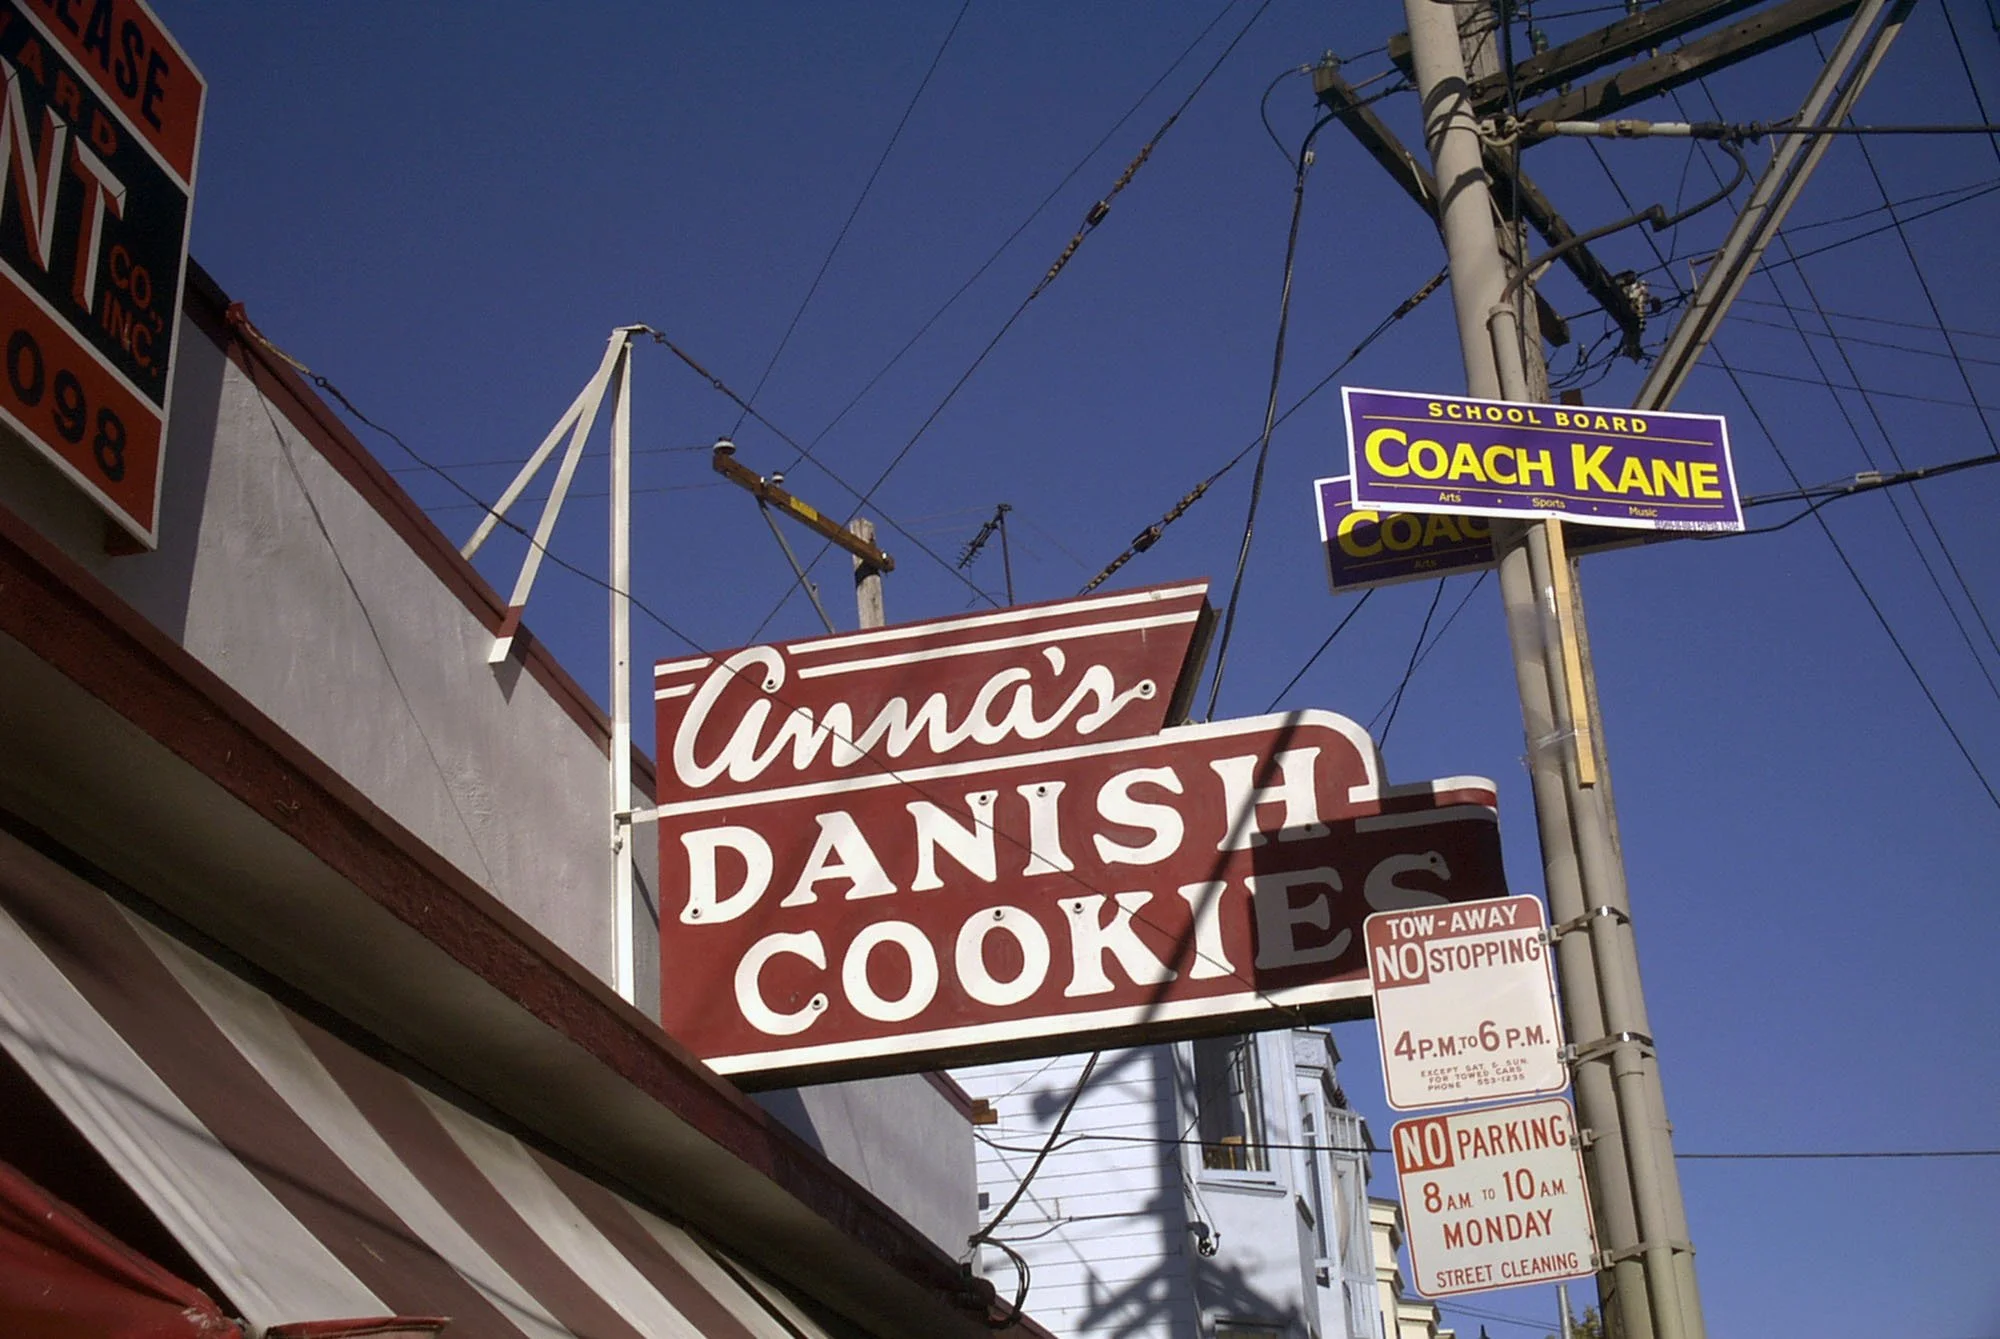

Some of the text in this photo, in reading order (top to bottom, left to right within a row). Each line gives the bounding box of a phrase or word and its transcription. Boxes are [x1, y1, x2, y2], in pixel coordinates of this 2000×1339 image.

[44, 0, 169, 132] EASE
[102, 289, 159, 378] INC.
[7, 329, 126, 482] 098
[1428, 402, 1648, 433] SCHOOL BOARD
[1364, 427, 1723, 499] COACH KANE
[1438, 491, 1658, 518] Arts Sports Music
[672, 645, 1157, 789] Anna's
[680, 743, 1326, 925] DANISH
[733, 850, 1453, 1036] COOKIES
[1386, 904, 1518, 941] TOW-AWAY
[1375, 936, 1541, 983] NO STOPPING
[1505, 1025, 1551, 1049] P.M.
[1420, 1066, 1459, 1078] EXCEPT
[1427, 1081, 1462, 1092] PHONE
[1428, 1066, 1523, 1084] FOR TOWED CARS
[1399, 1115, 1567, 1169] NO PARKING
[1423, 1181, 1443, 1214] 8
[1482, 1188, 1496, 1201] TO
[1502, 1168, 1536, 1202] 10
[1442, 1208, 1553, 1250] MONDAY
[1436, 1252, 1579, 1289] STREET CLEANING
